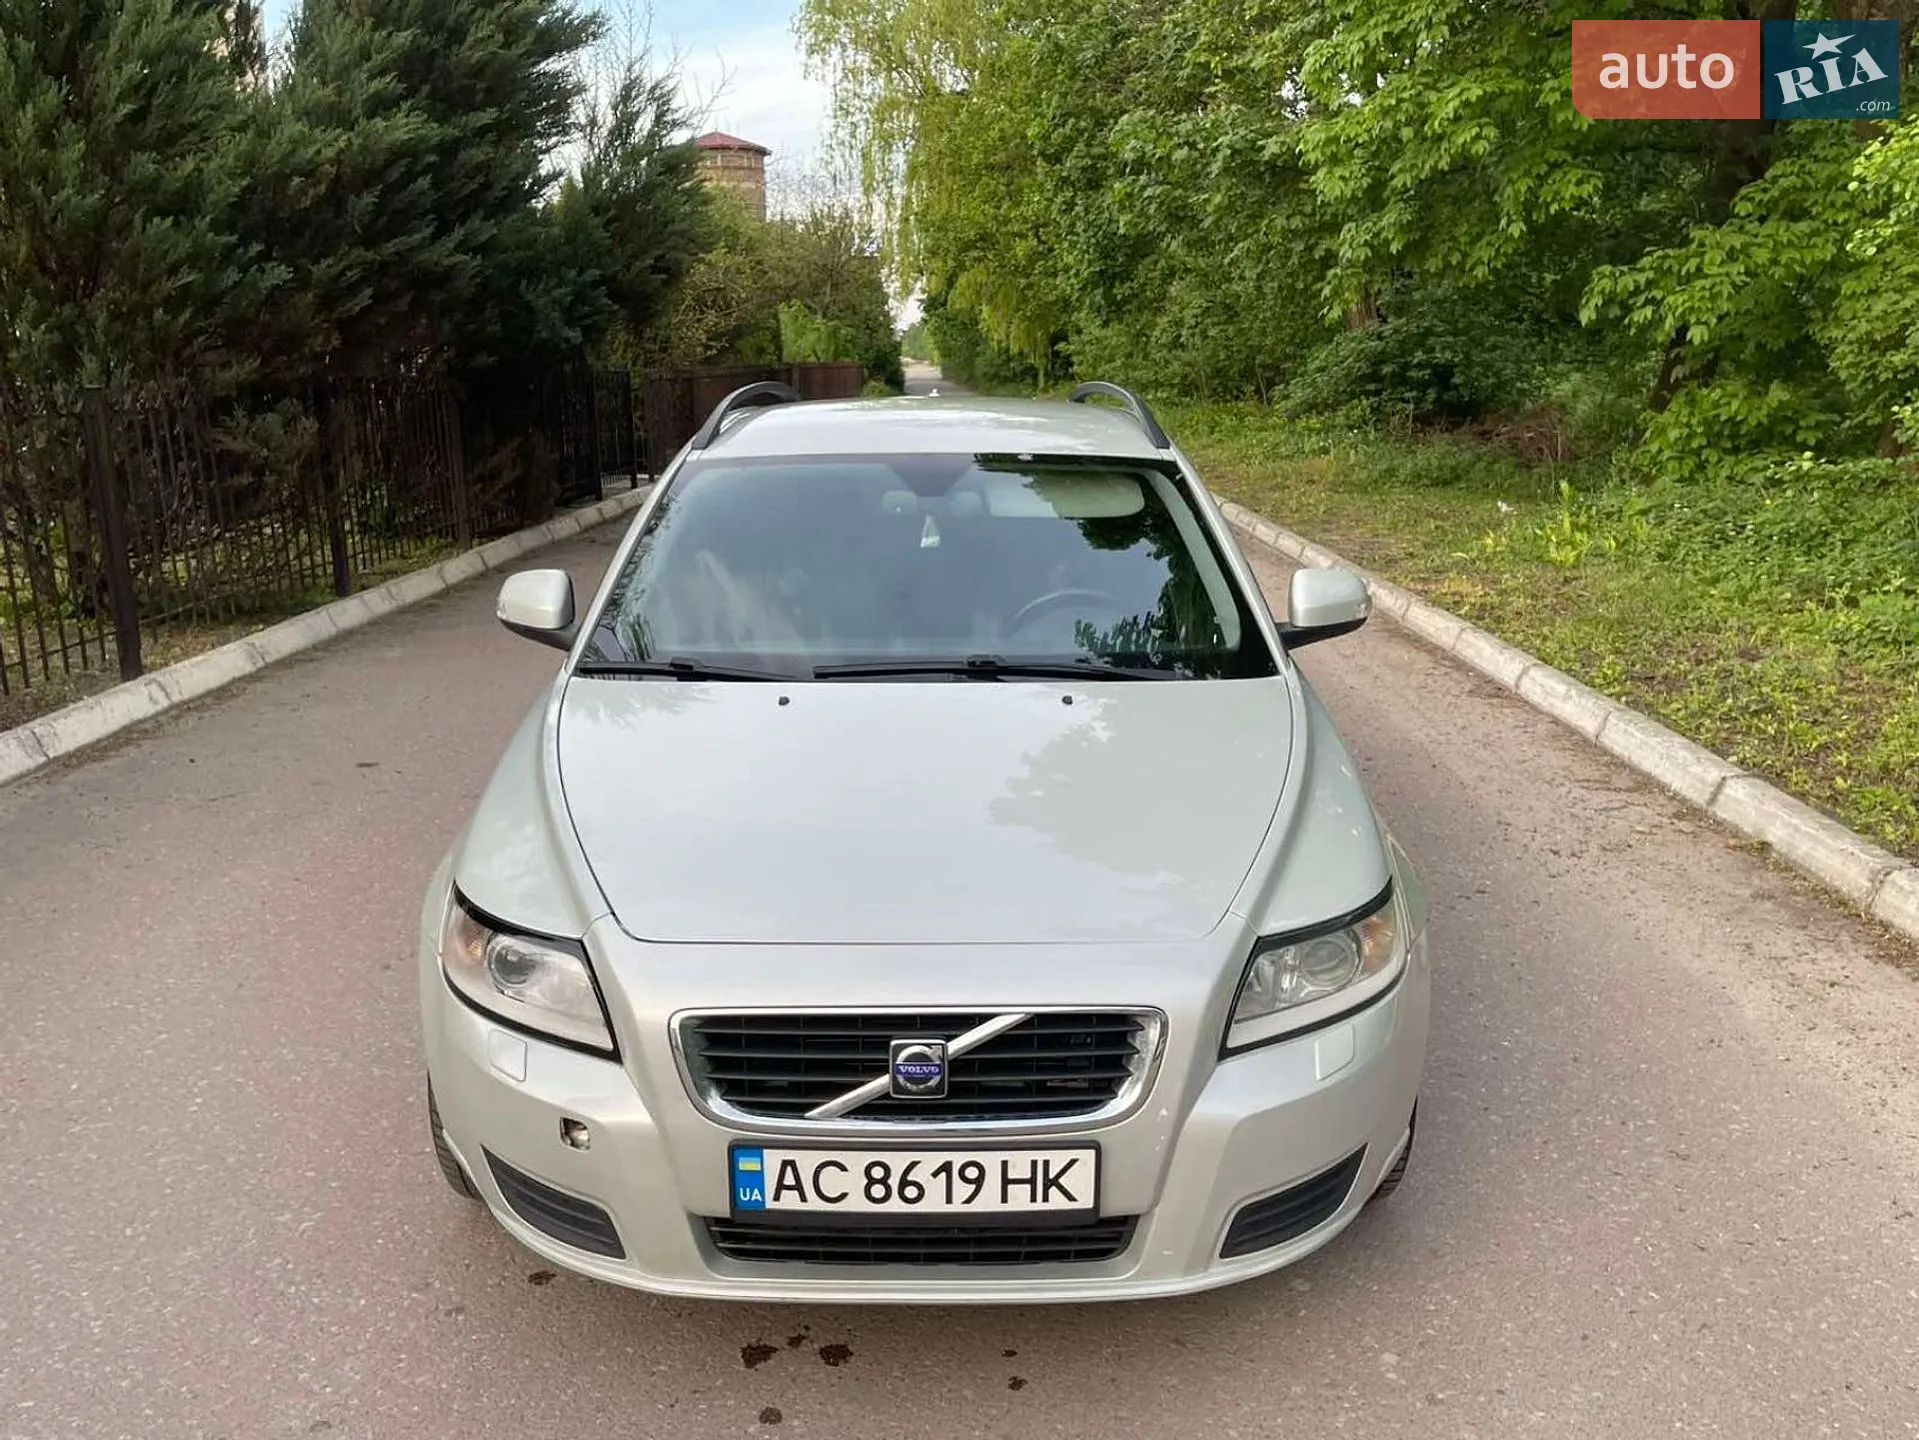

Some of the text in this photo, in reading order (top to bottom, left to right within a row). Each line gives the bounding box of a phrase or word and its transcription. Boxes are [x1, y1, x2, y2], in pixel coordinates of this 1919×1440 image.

[898, 1065, 940, 1074] VOLVO
[772, 1158, 1080, 1205] AC 8619 HK
[739, 1187, 763, 1201] UA
